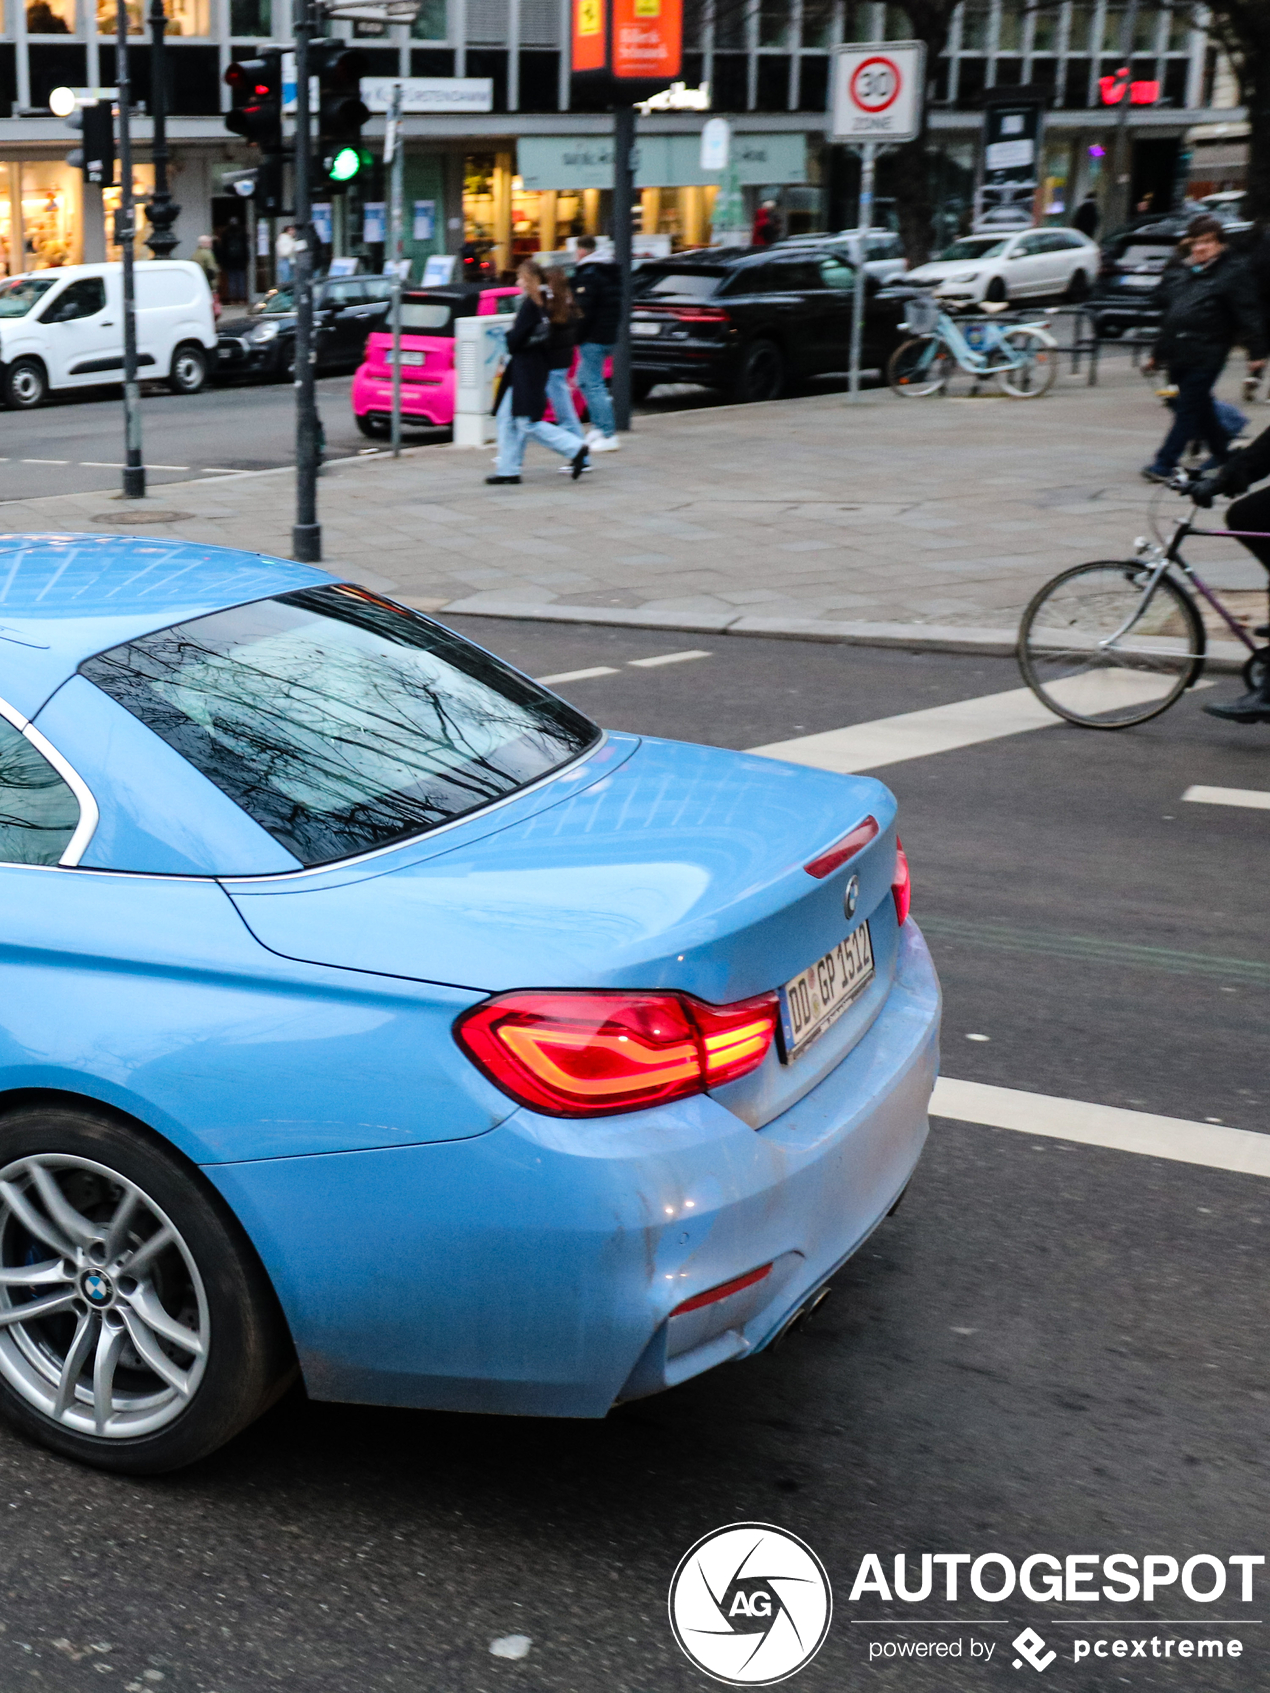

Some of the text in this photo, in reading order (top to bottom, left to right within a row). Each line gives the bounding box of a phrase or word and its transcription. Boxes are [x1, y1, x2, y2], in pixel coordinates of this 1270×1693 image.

[375, 86, 489, 102] KFÜRSTENDAMM
[859, 72, 893, 97] 30
[852, 116, 893, 131] ZONE
[789, 978, 811, 1035] DD
[817, 953, 836, 1006] GP
[837, 923, 870, 987] 1512
